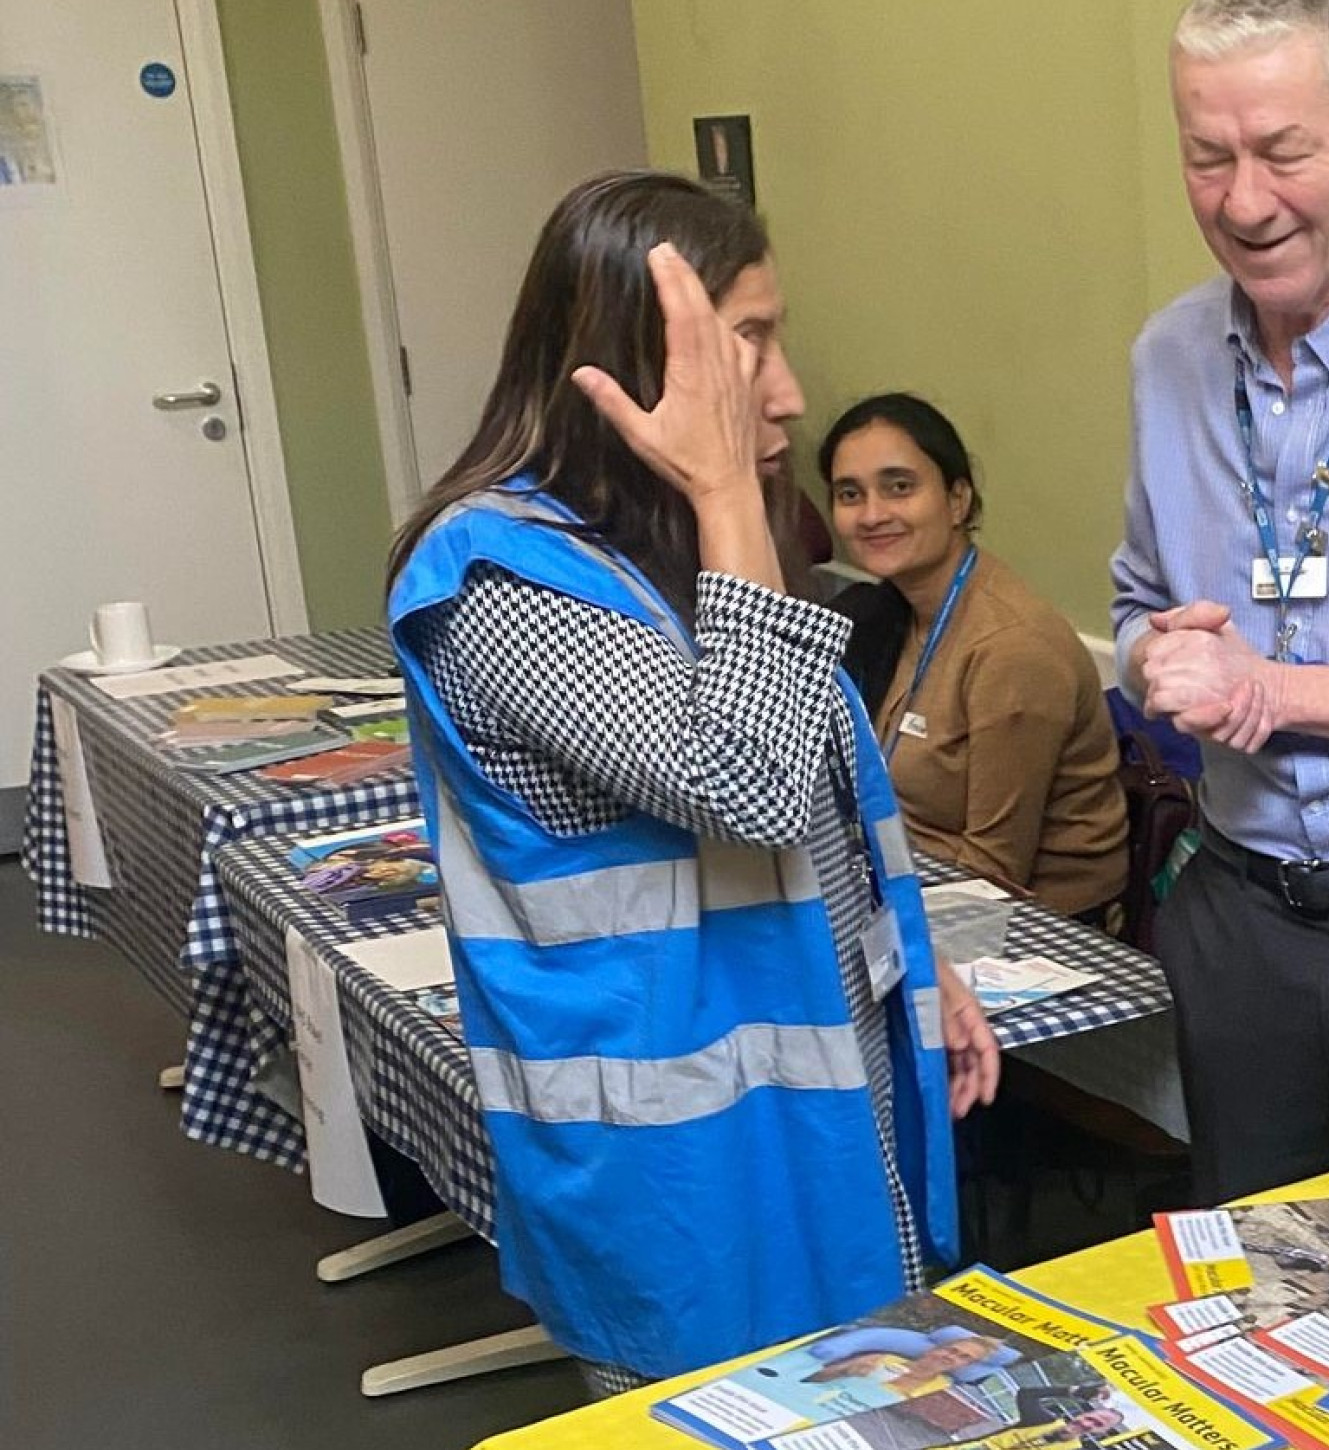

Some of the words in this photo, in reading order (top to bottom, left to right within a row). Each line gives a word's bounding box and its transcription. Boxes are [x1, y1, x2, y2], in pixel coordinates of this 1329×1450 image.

[950, 1282, 1036, 1325] Macular
[1036, 1319, 1091, 1348] Matt
[1097, 1346, 1170, 1404] Macular
[1164, 1401, 1240, 1450] Matters
